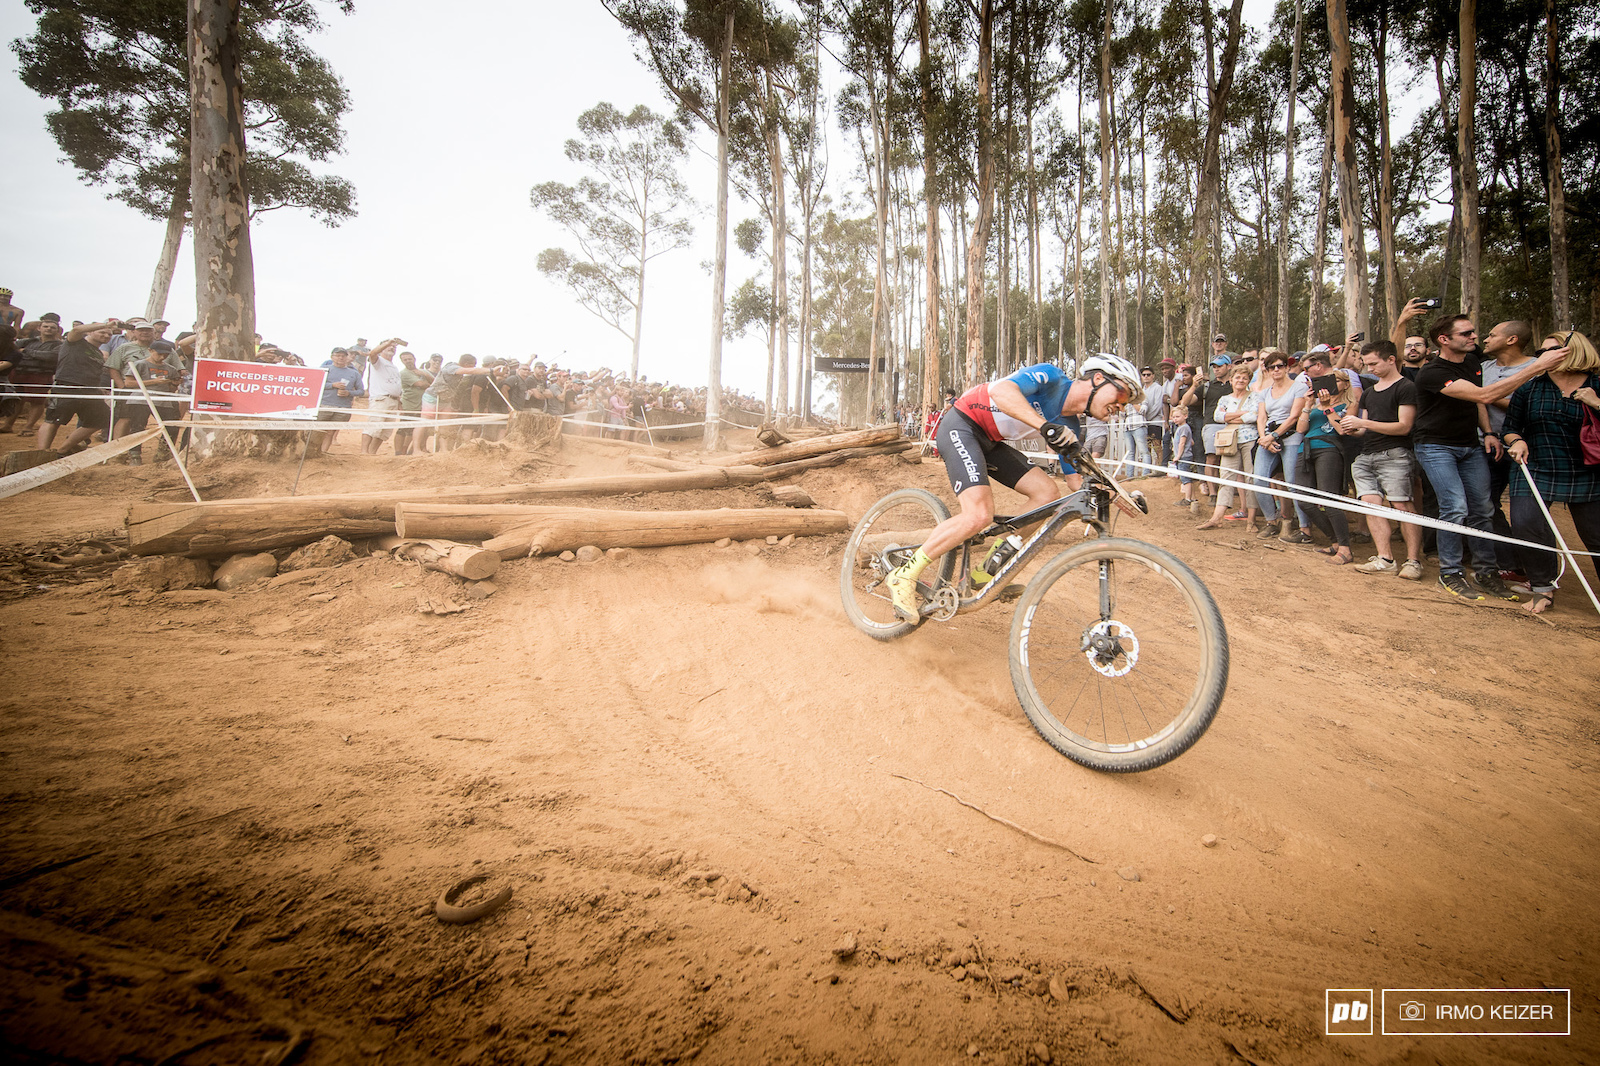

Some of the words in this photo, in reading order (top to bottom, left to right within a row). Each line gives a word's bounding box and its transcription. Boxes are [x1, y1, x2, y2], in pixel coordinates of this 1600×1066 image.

[216, 370, 305, 384] MERCEDES-BENZ
[206, 380, 260, 394] PICKUP
[263, 384, 310, 397] STICKS
[949, 429, 981, 483] cannondale
